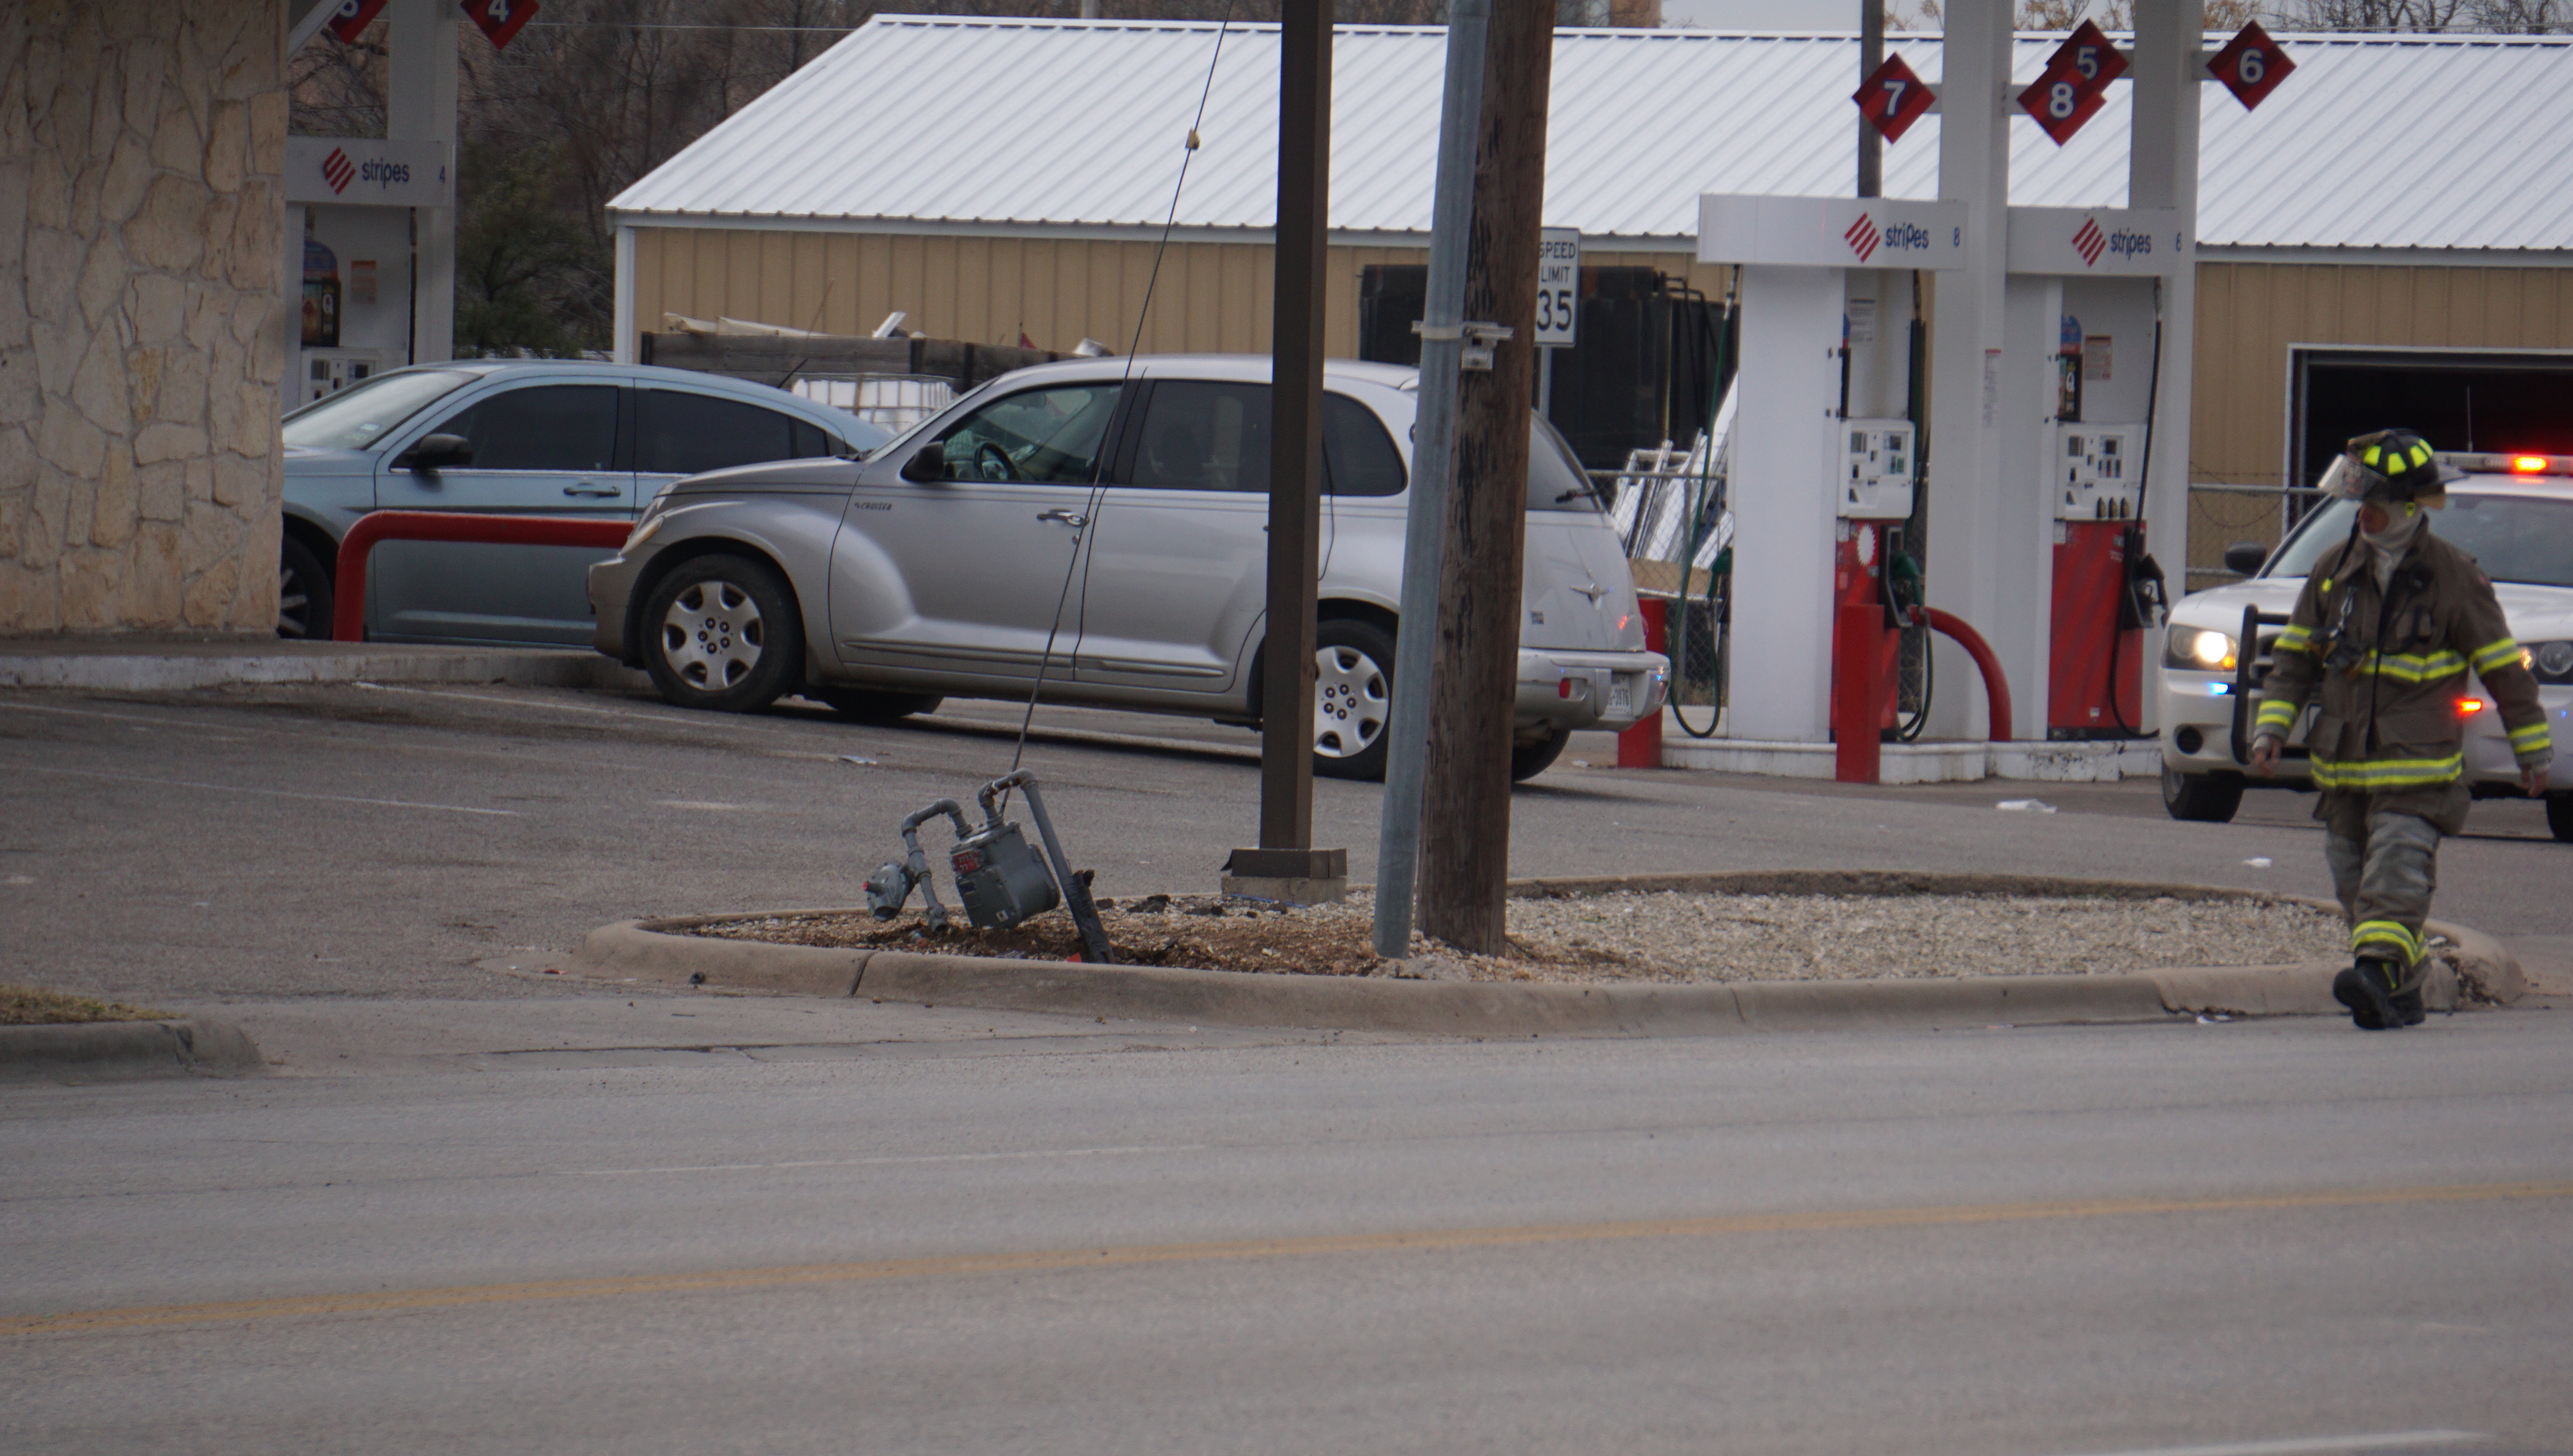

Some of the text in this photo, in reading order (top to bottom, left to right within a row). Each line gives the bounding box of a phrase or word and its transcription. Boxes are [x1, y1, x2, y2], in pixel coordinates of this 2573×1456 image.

[487, 0, 510, 22] 4
[2076, 46, 2098, 80] 5
[2238, 48, 2265, 84] 6
[1883, 80, 1907, 117] 7
[2048, 82, 2075, 119] 8
[362, 159, 445, 189] stripes 4
[1540, 241, 1576, 259] SPEED
[1885, 222, 1960, 252] stripes 8
[2111, 228, 2182, 260] stripes 6
[1541, 266, 1571, 283] LIMIT
[1537, 289, 1572, 332] 35
